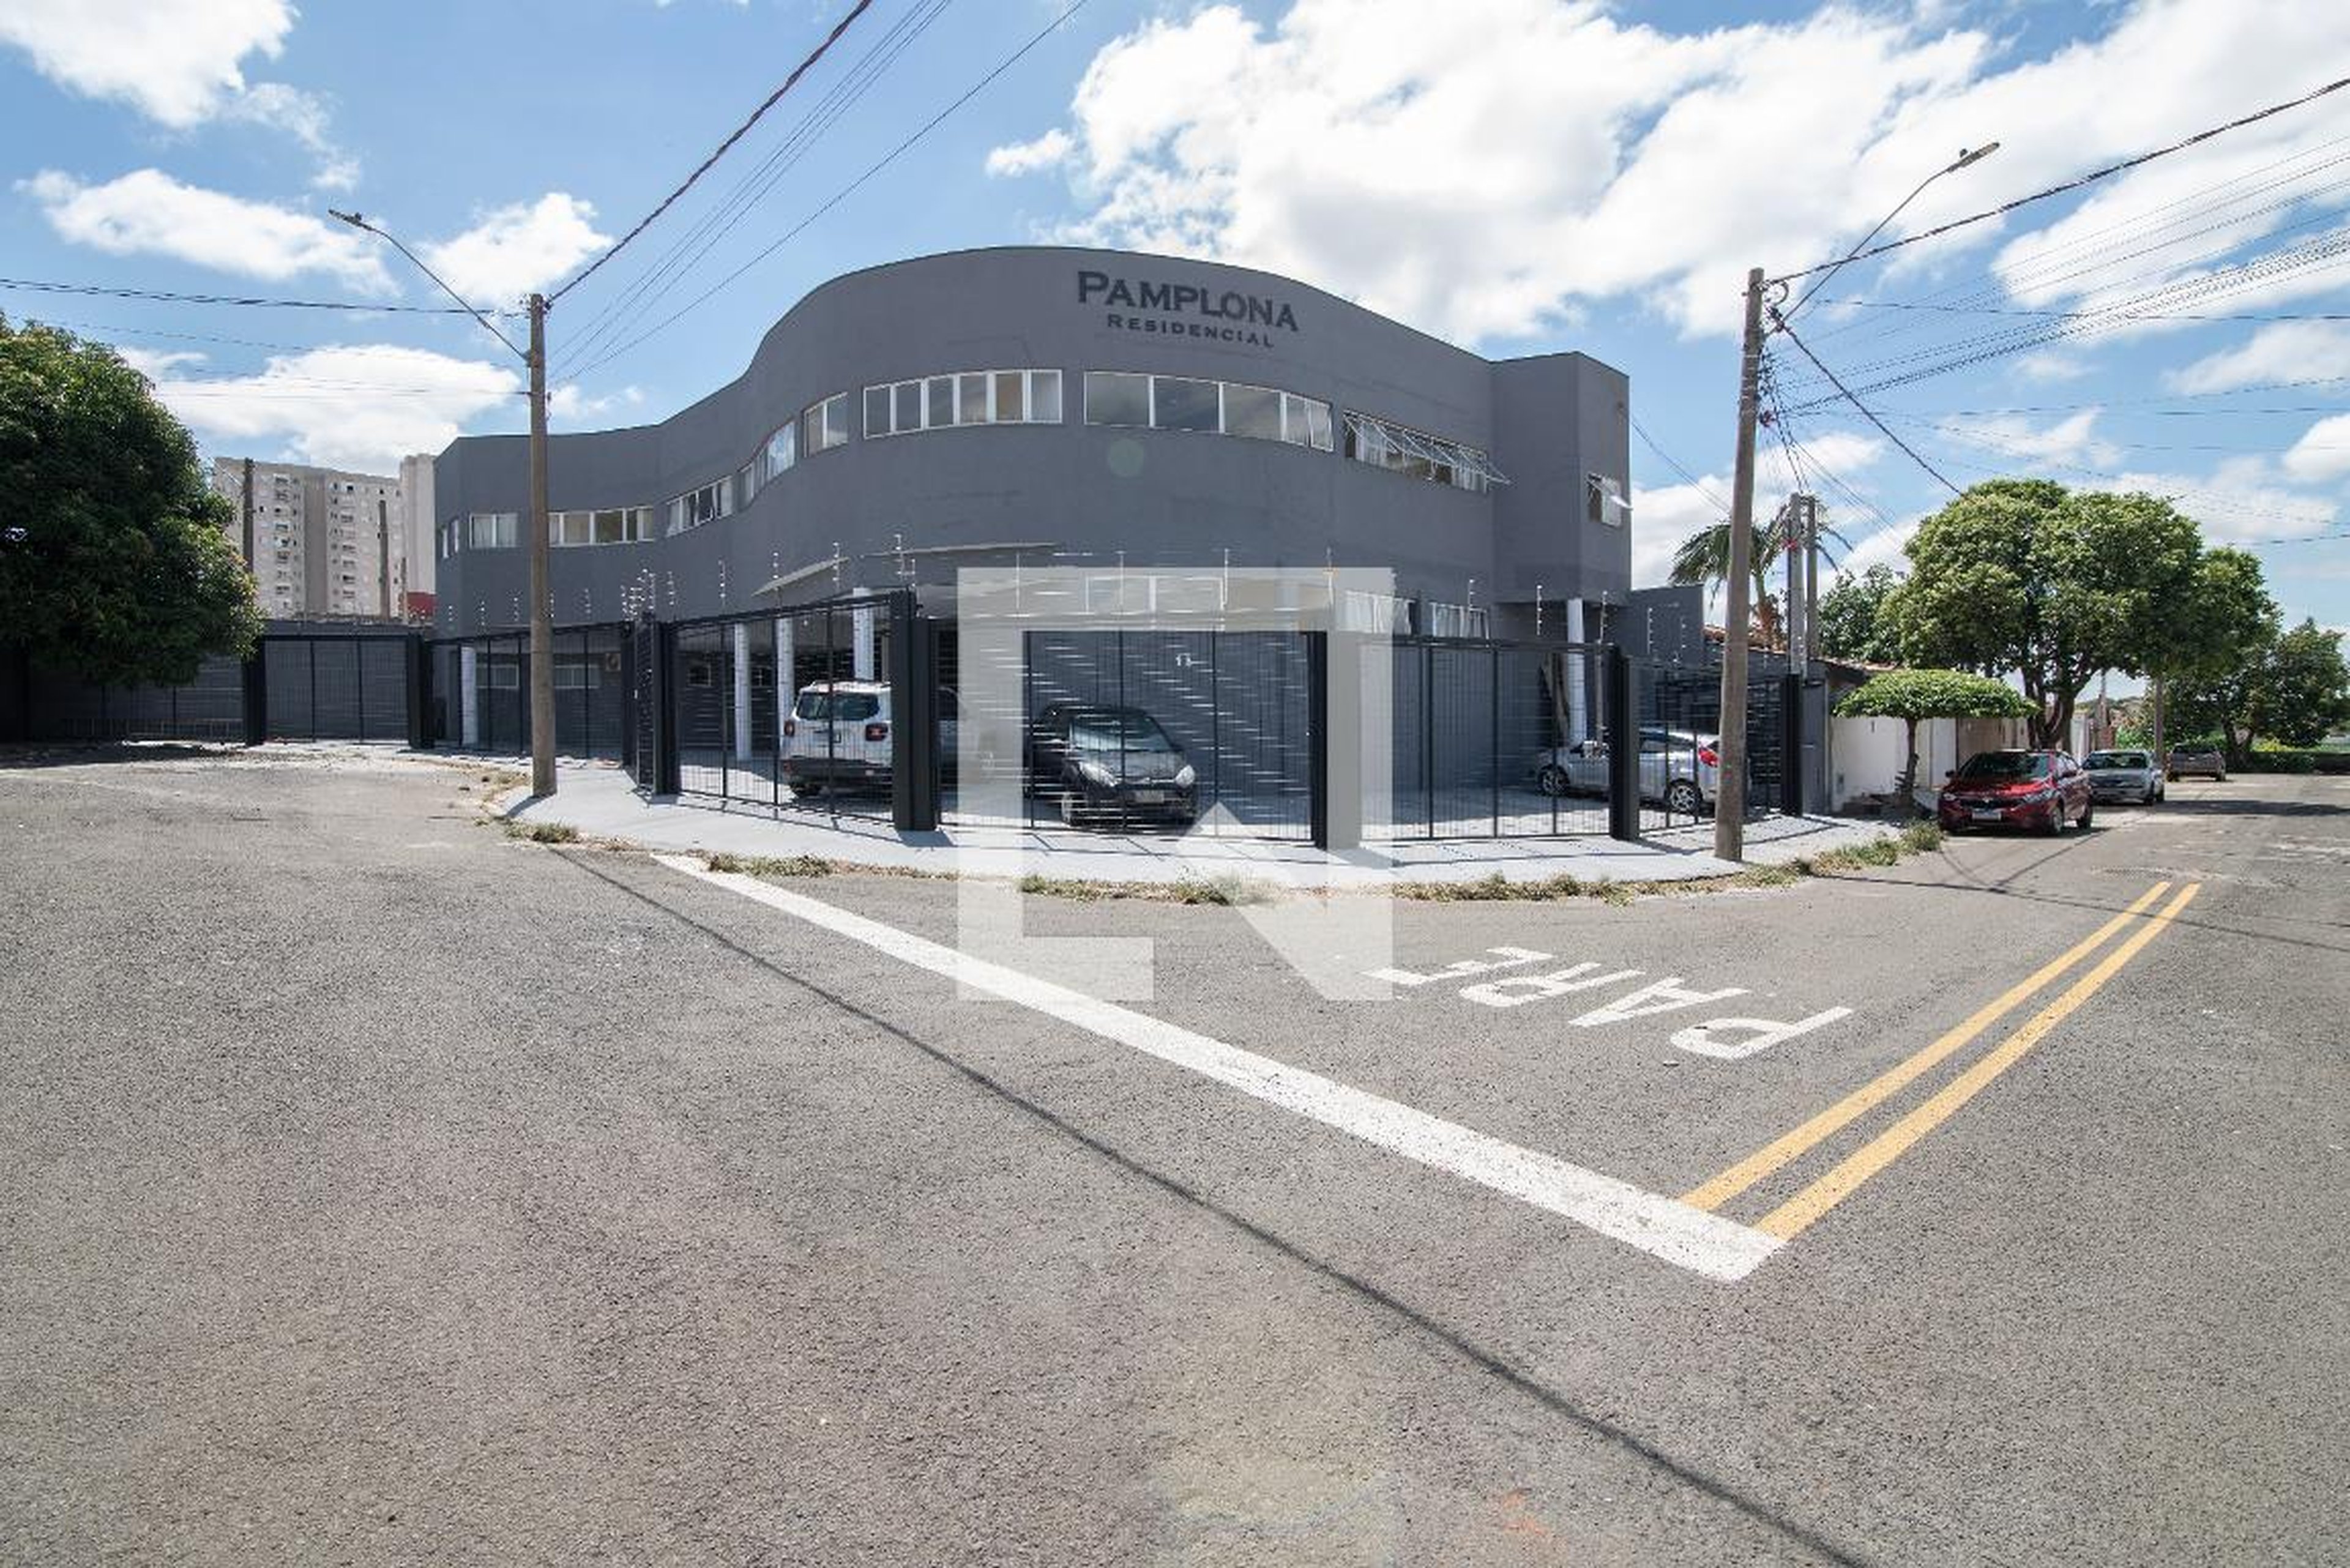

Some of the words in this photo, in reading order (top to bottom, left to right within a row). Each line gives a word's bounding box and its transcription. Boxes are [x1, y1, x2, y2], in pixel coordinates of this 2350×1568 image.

[1078, 271, 1299, 331] PAMPLONA
[1107, 313, 1274, 348] RESIDENCIAL
[1360, 946, 1854, 1060] PARE
